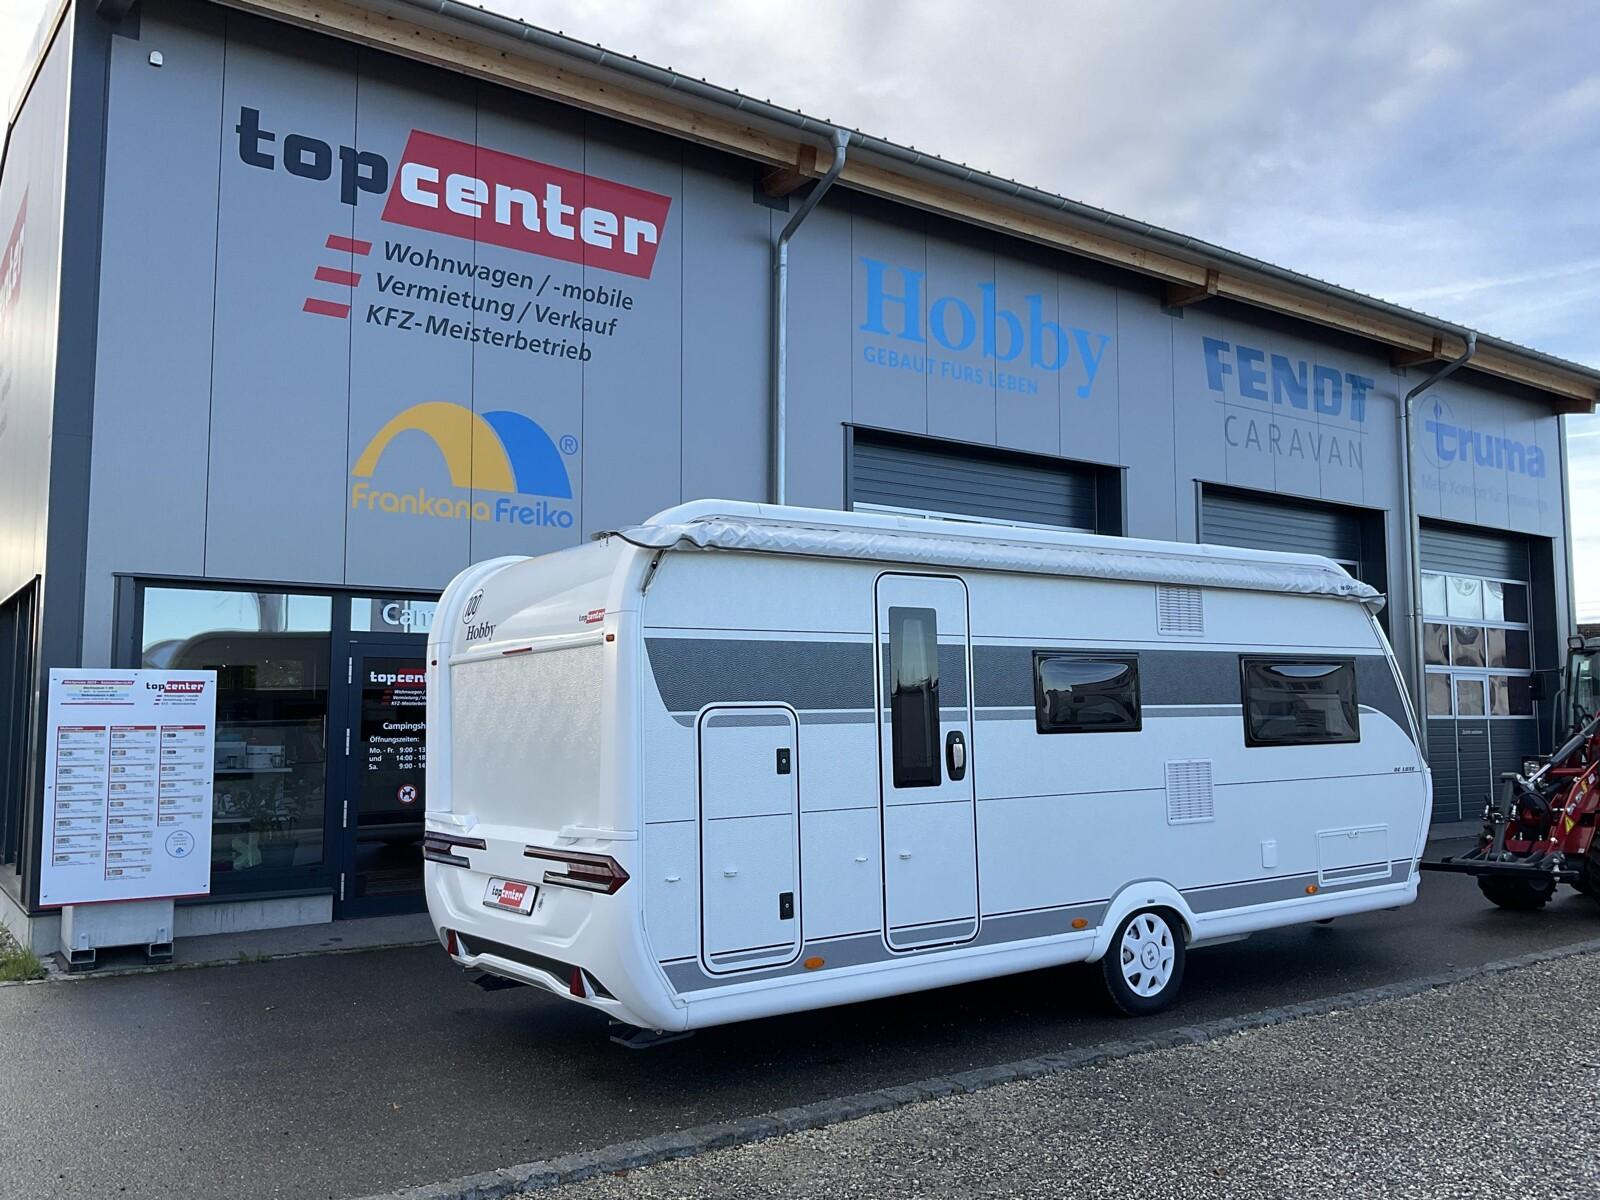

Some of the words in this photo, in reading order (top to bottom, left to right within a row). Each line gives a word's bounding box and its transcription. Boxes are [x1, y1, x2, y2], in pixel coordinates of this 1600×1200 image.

[365, 304, 593, 362] KFZ-Meisterbetrieb
[858, 255, 1111, 399] Hobby
[863, 346, 937, 375] GEBAUT
[989, 372, 1039, 396] LEBEN
[1202, 335, 1375, 423] FENDT
[1224, 415, 1363, 471] CARAVAN
[1424, 419, 1547, 479] truma
[351, 482, 492, 522] Frankana
[494, 498, 574, 529] Freiko
[466, 621, 496, 641] Hobby
[491, 884, 524, 901] topcenter
